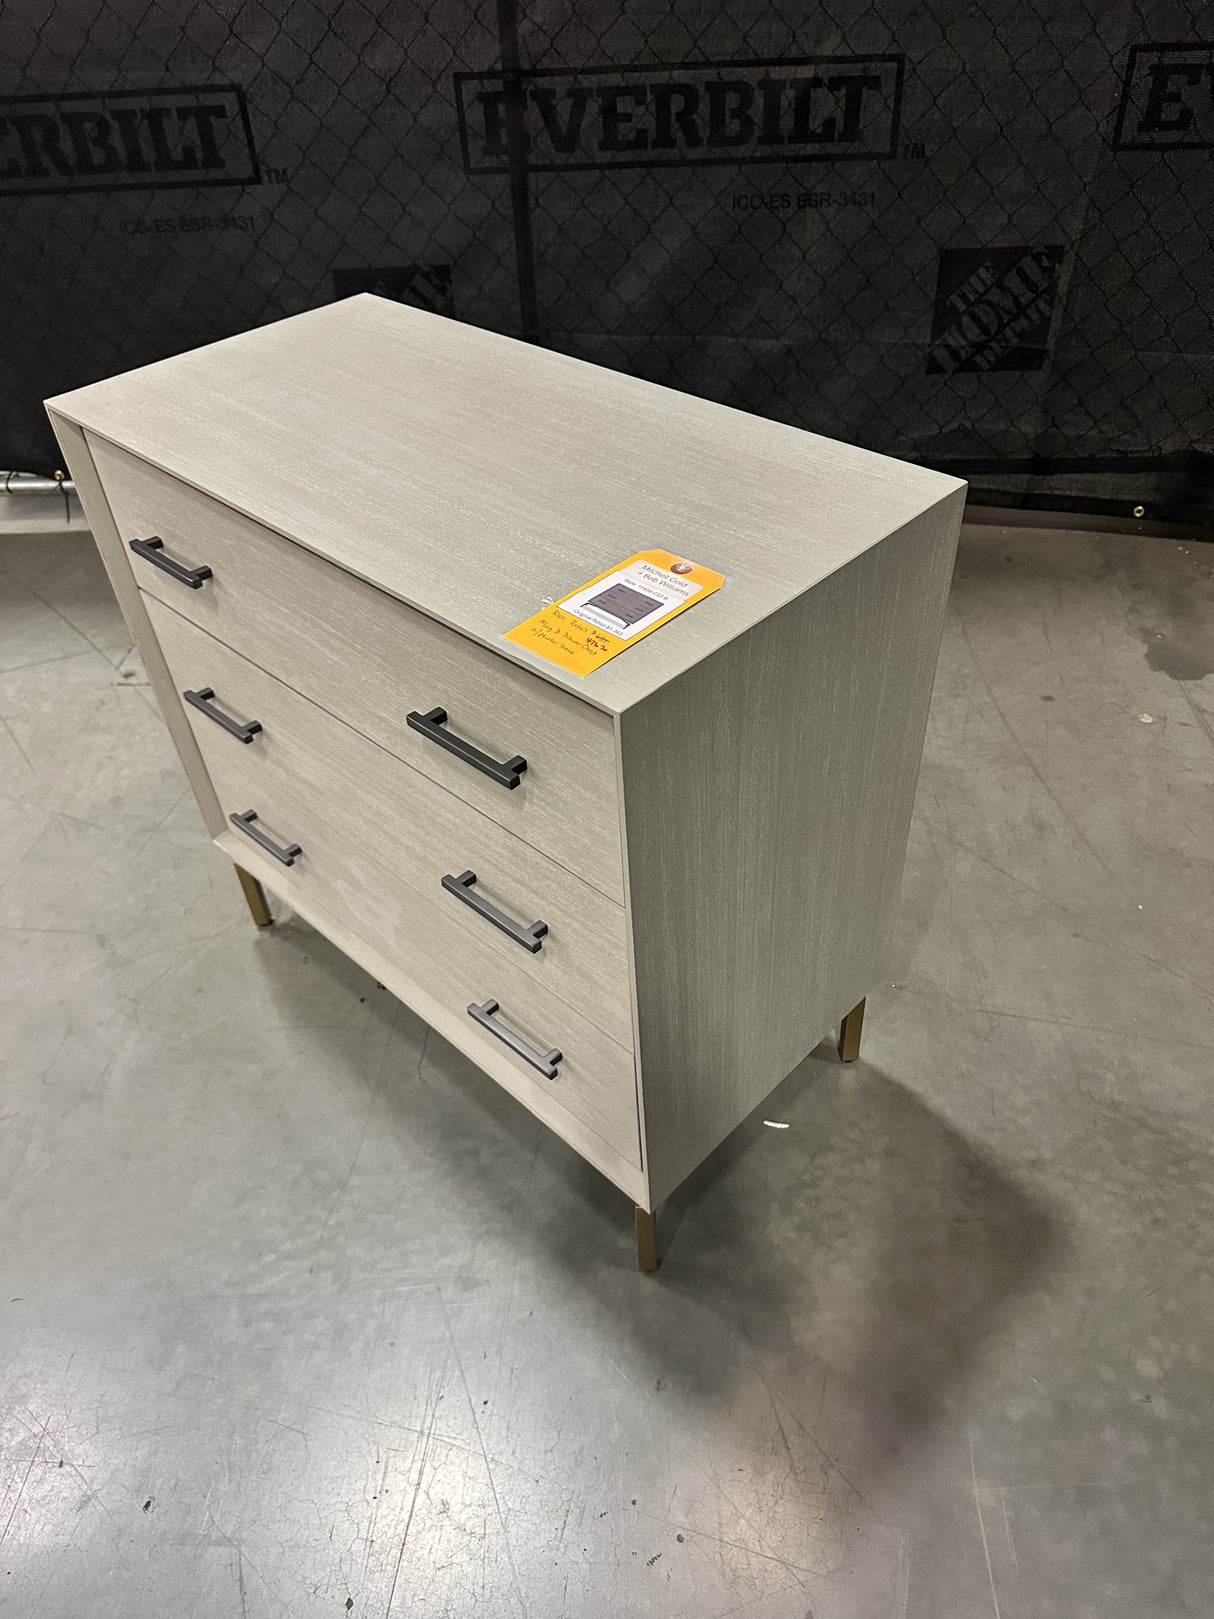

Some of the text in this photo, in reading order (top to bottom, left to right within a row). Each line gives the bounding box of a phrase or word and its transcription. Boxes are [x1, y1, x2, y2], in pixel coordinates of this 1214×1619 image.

[475, 74, 882, 157] EVERBILT
[925, 247, 1055, 374] HOME
[946, 260, 997, 314] THE
[640, 564, 689, 588] Mitchell Gold
[642, 573, 659, 583] Bob
[658, 579, 690, 597] Williams
